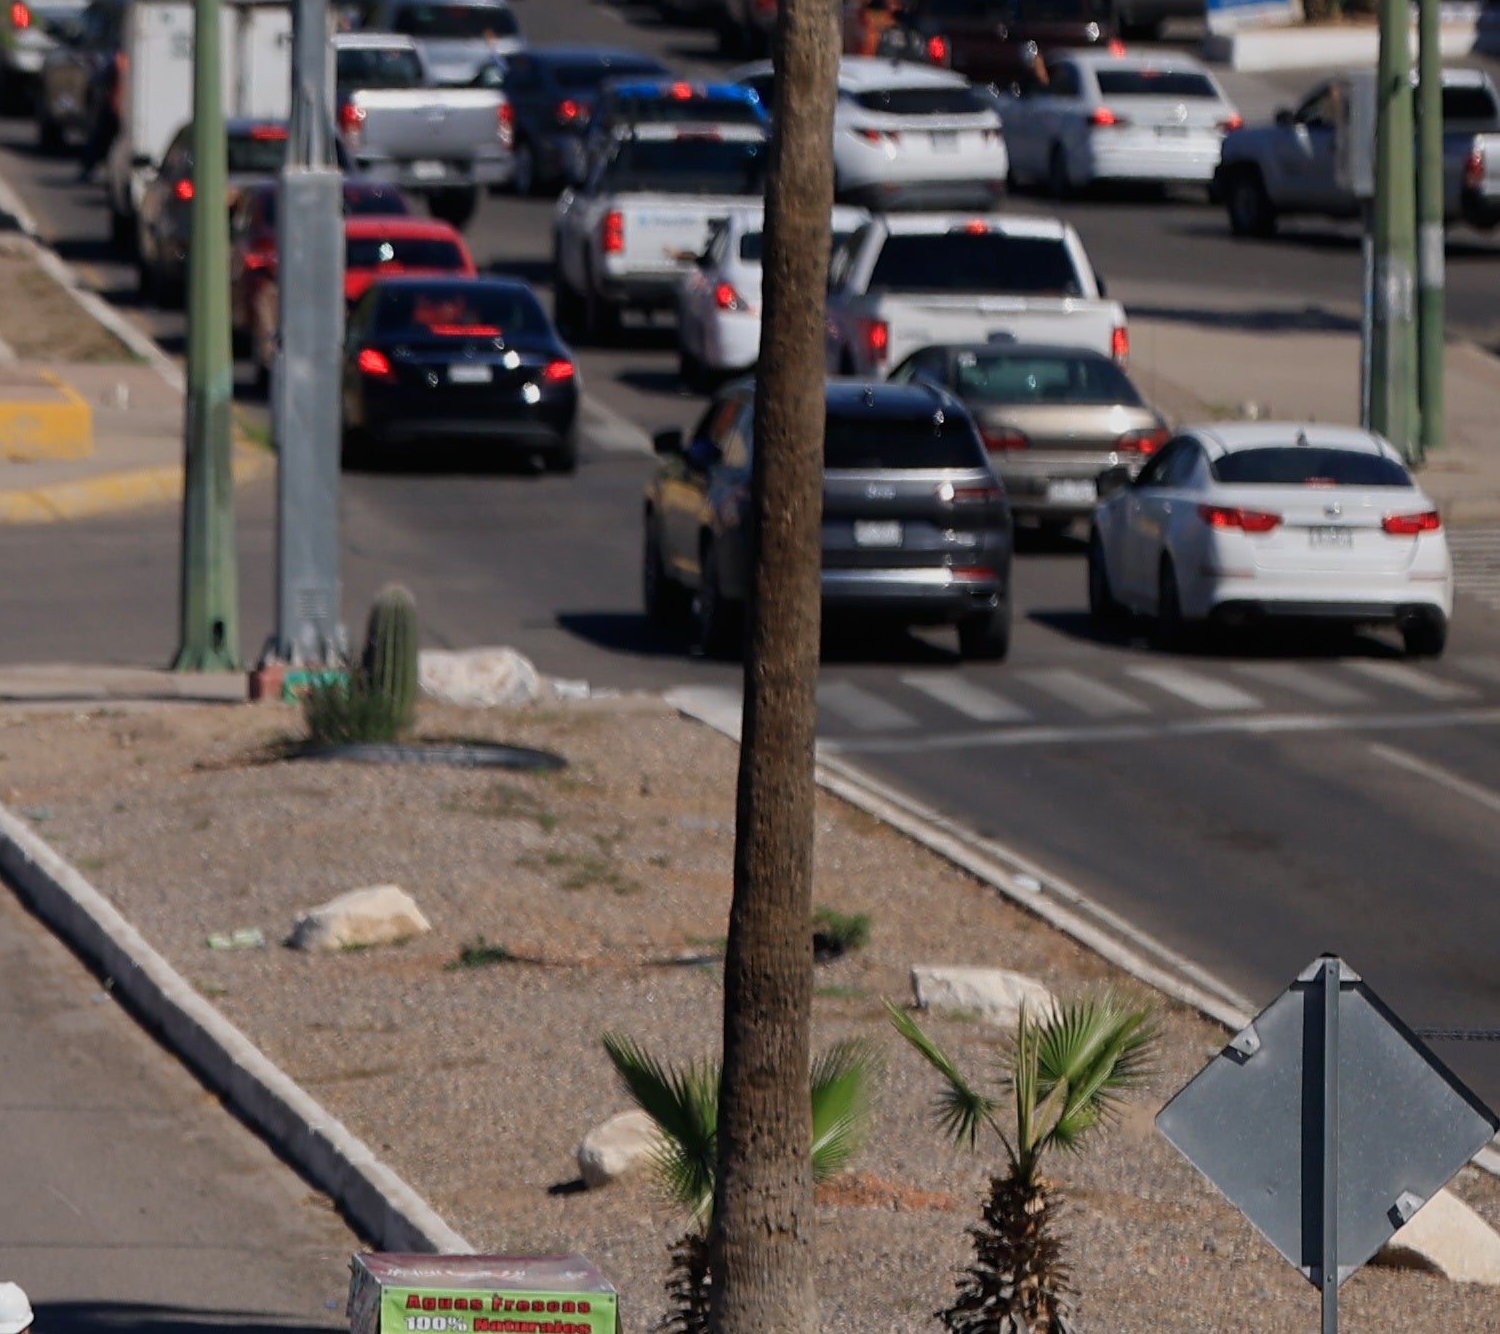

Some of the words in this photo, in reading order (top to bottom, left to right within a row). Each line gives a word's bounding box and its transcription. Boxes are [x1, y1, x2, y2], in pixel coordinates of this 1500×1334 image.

[406, 1295, 484, 1311] Aguas
[492, 1297, 592, 1315] Frescas
[404, 1315, 468, 1333] 100%
